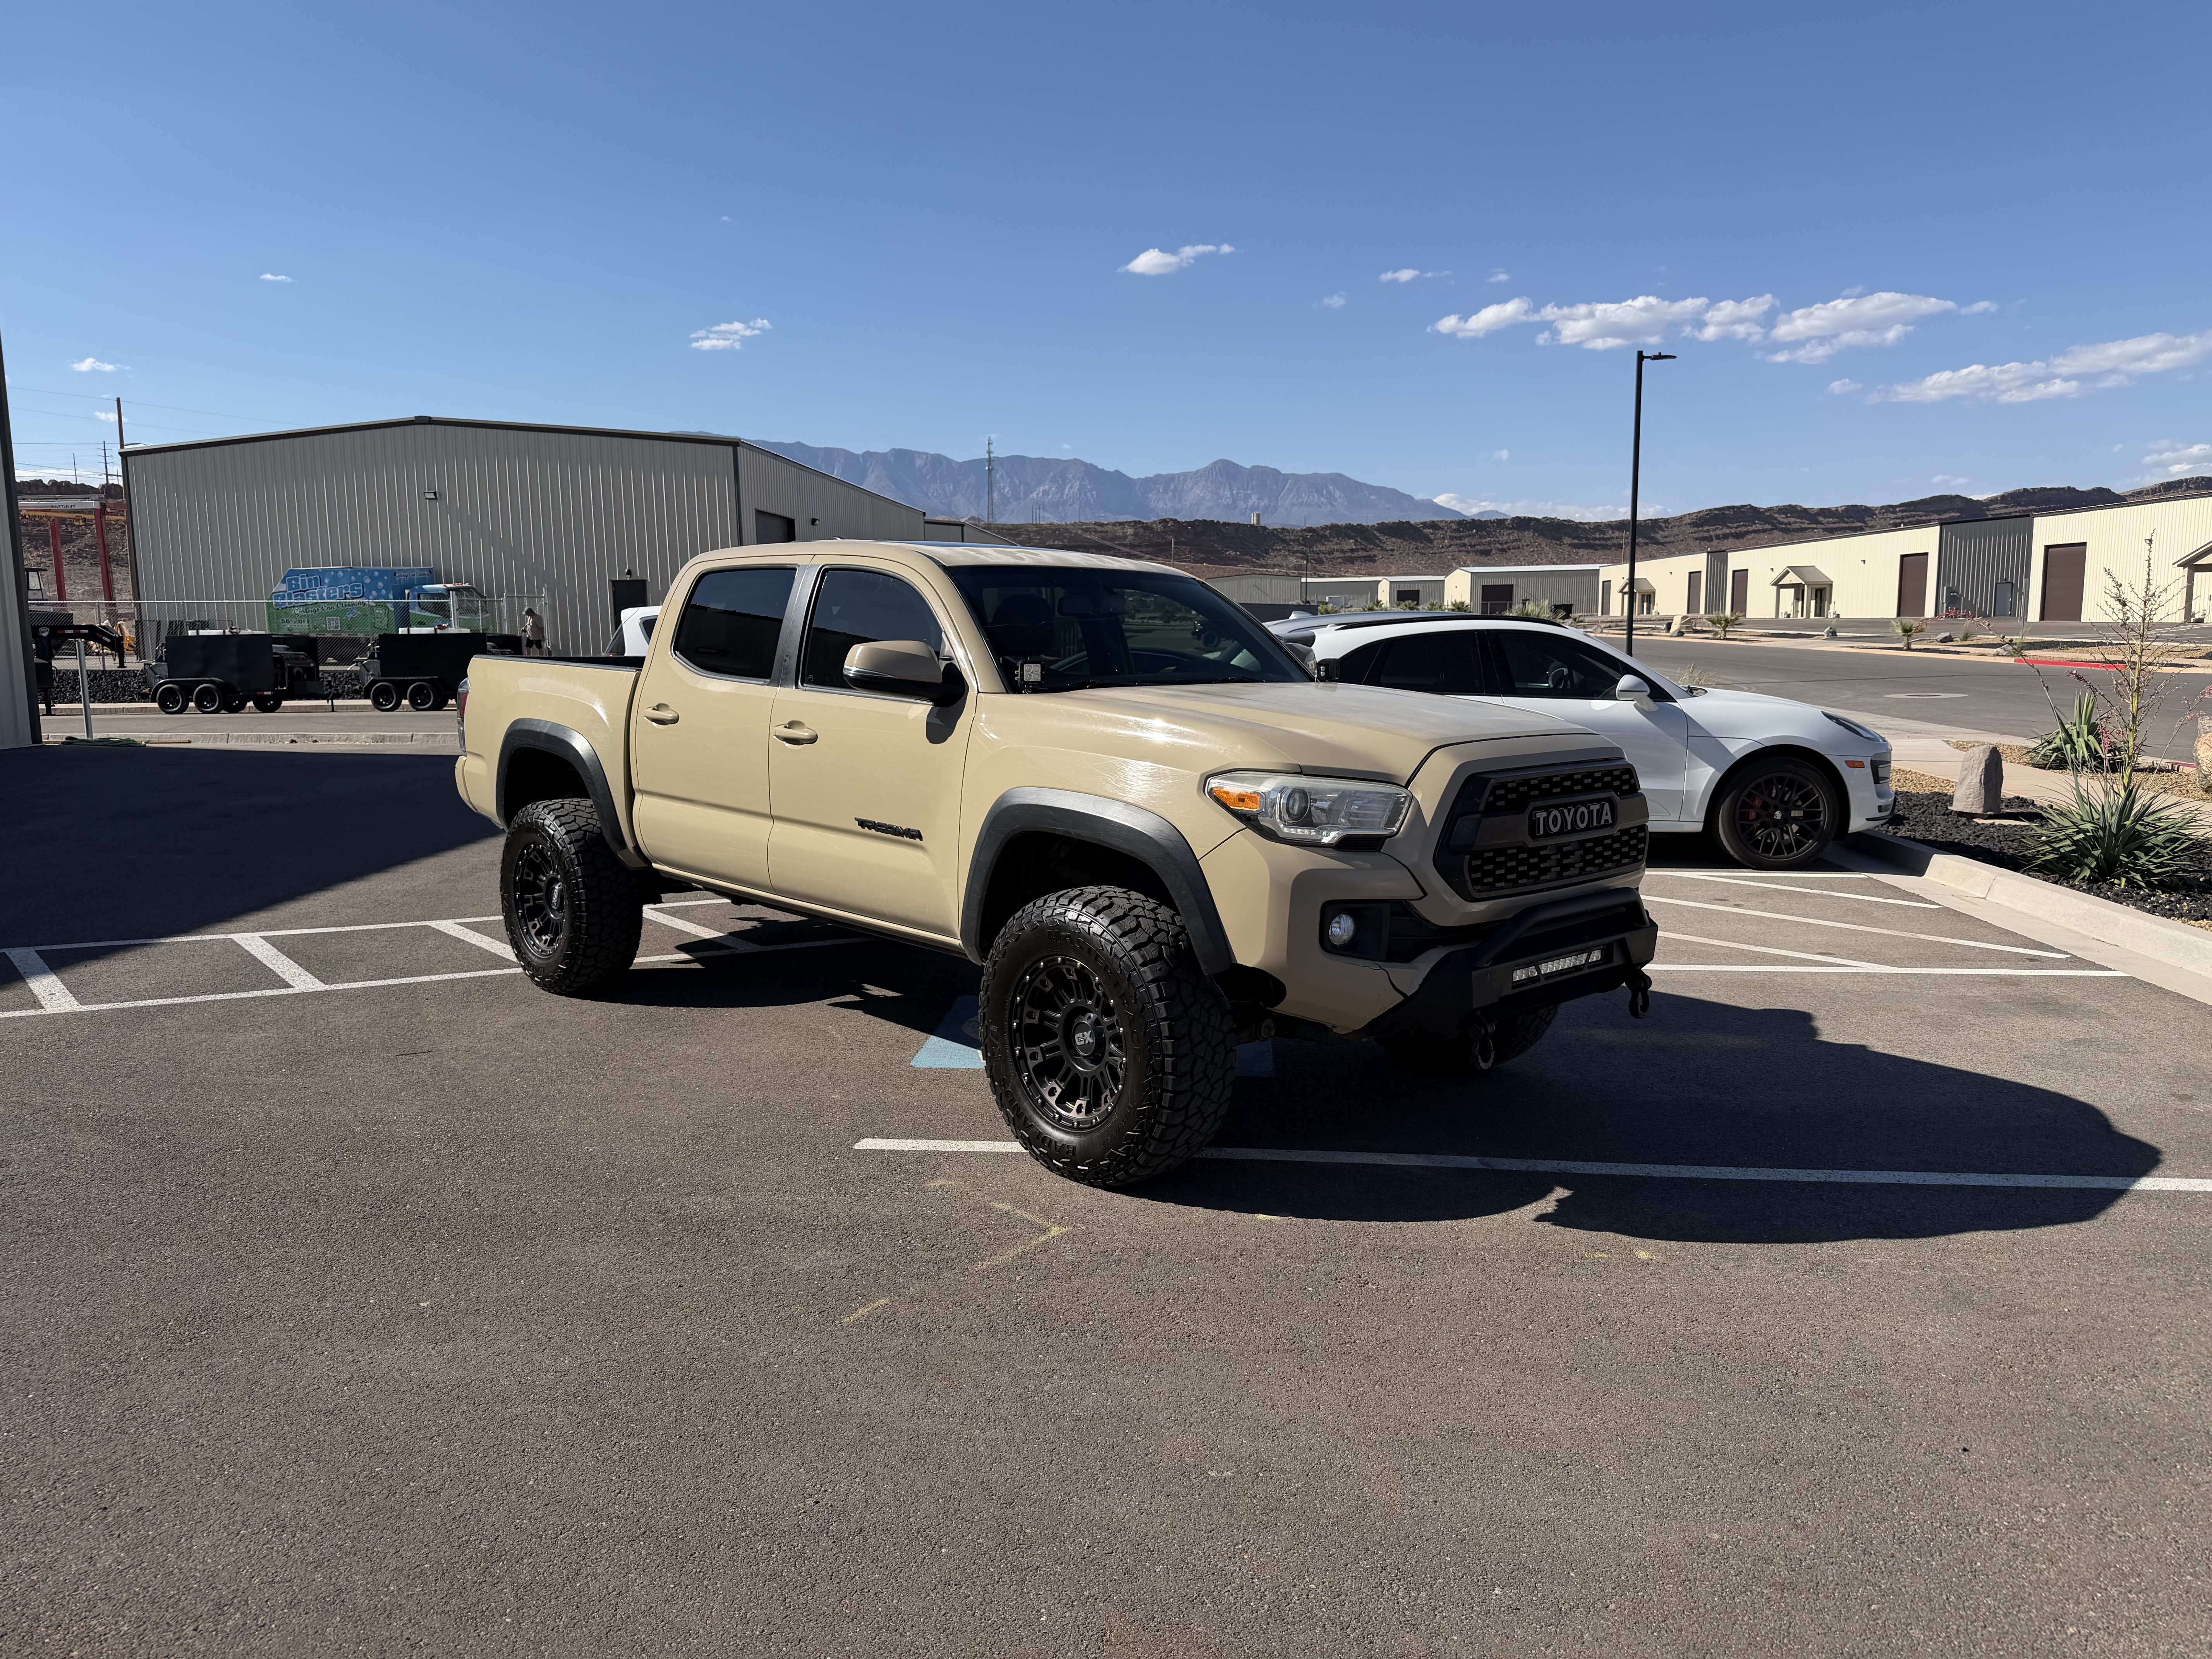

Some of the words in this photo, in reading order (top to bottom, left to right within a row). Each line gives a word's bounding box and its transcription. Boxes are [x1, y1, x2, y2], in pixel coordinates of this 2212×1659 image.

[272, 582, 363, 609] Blasters
[286, 574, 321, 592] Bin
[294, 606, 320, 617] Garbage
[321, 604, 336, 612] Can
[854, 817, 923, 841] TACOMA
[1533, 802, 1612, 836] TOYOTA
[1047, 929, 1142, 1065] MASTERTRACK
[998, 1076, 1077, 1158] BADLANDS
